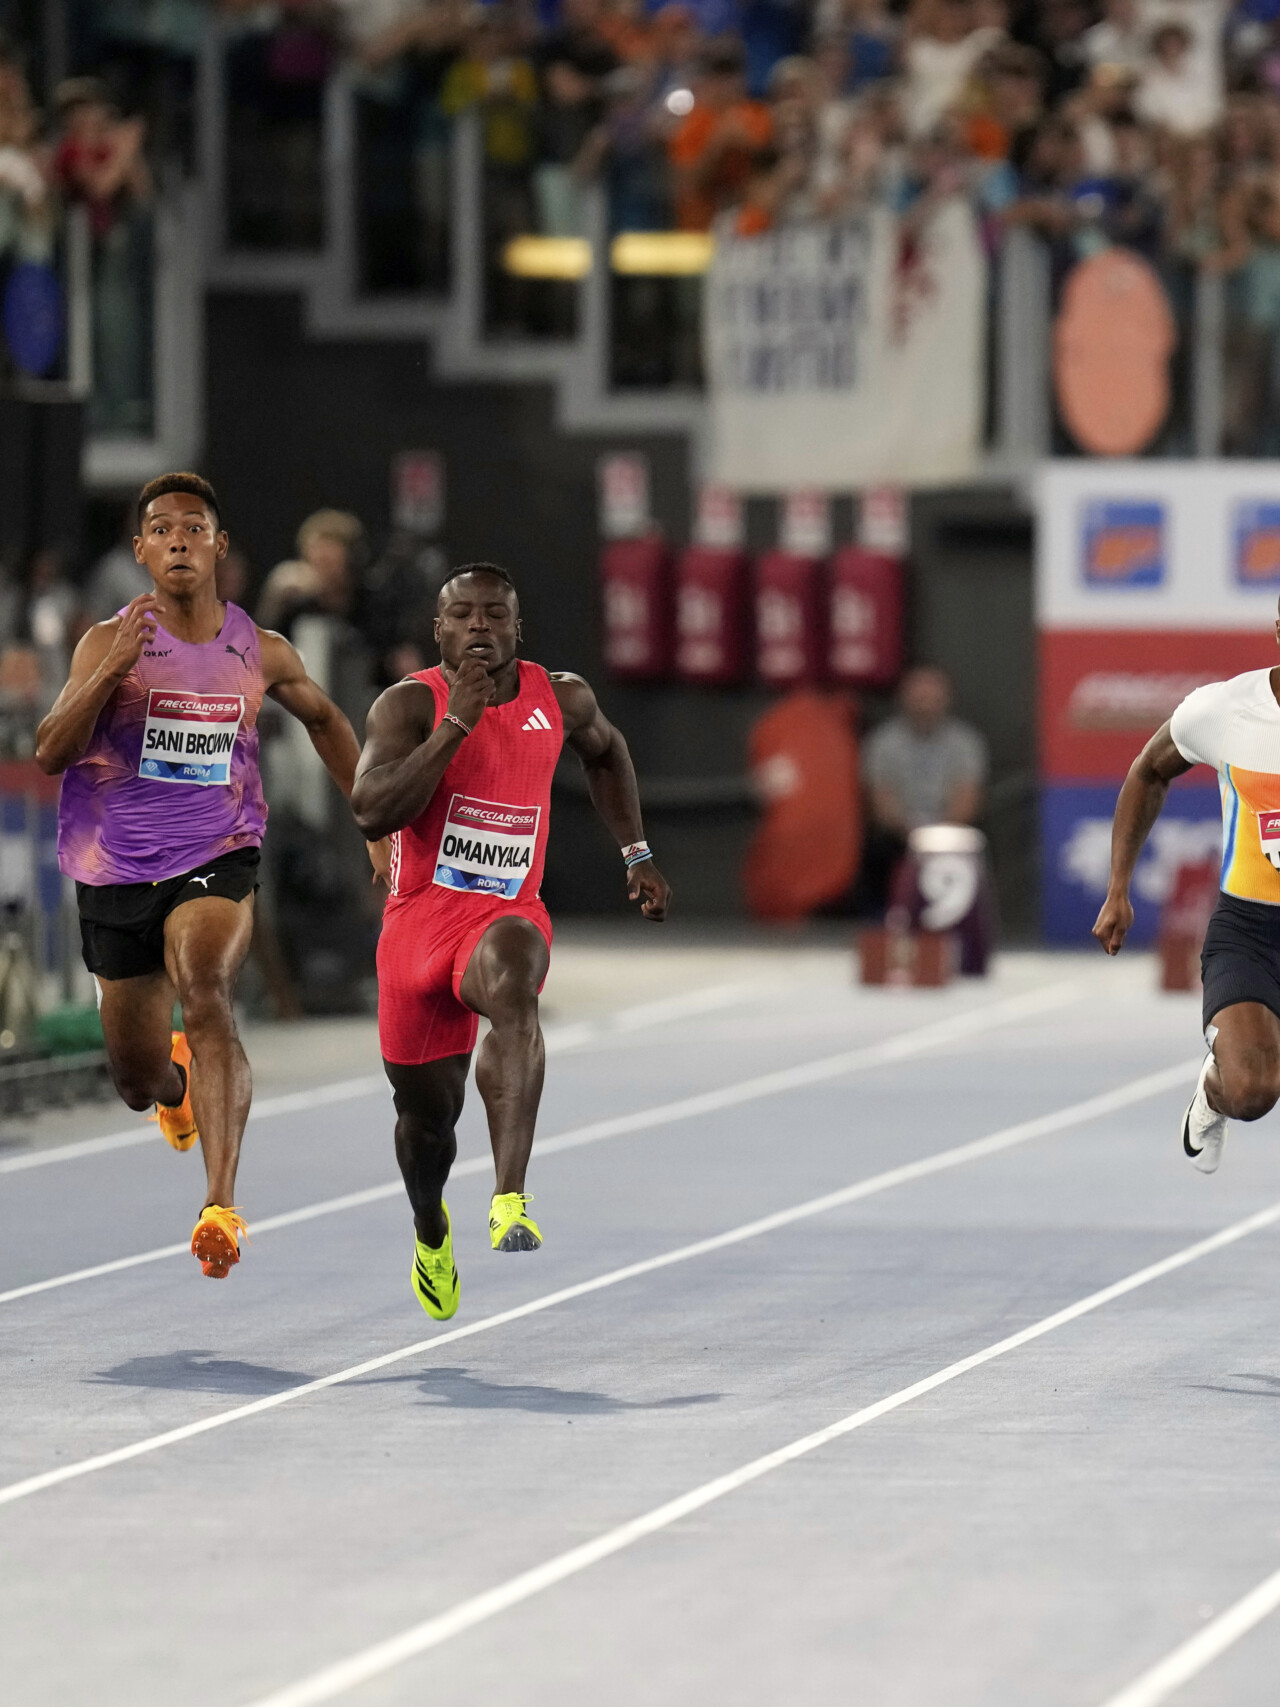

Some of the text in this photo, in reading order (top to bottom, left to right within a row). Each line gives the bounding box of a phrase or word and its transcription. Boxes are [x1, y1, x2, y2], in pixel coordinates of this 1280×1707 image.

[156, 699, 239, 713] FRECCIAROSSA
[145, 728, 235, 755] SANI BROWN
[183, 766, 211, 778] ROMA
[457, 805, 534, 824] FRECCIAROSSA
[442, 834, 530, 868] OMANYALA
[477, 878, 506, 890] ROMA
[918, 853, 977, 931] 9
